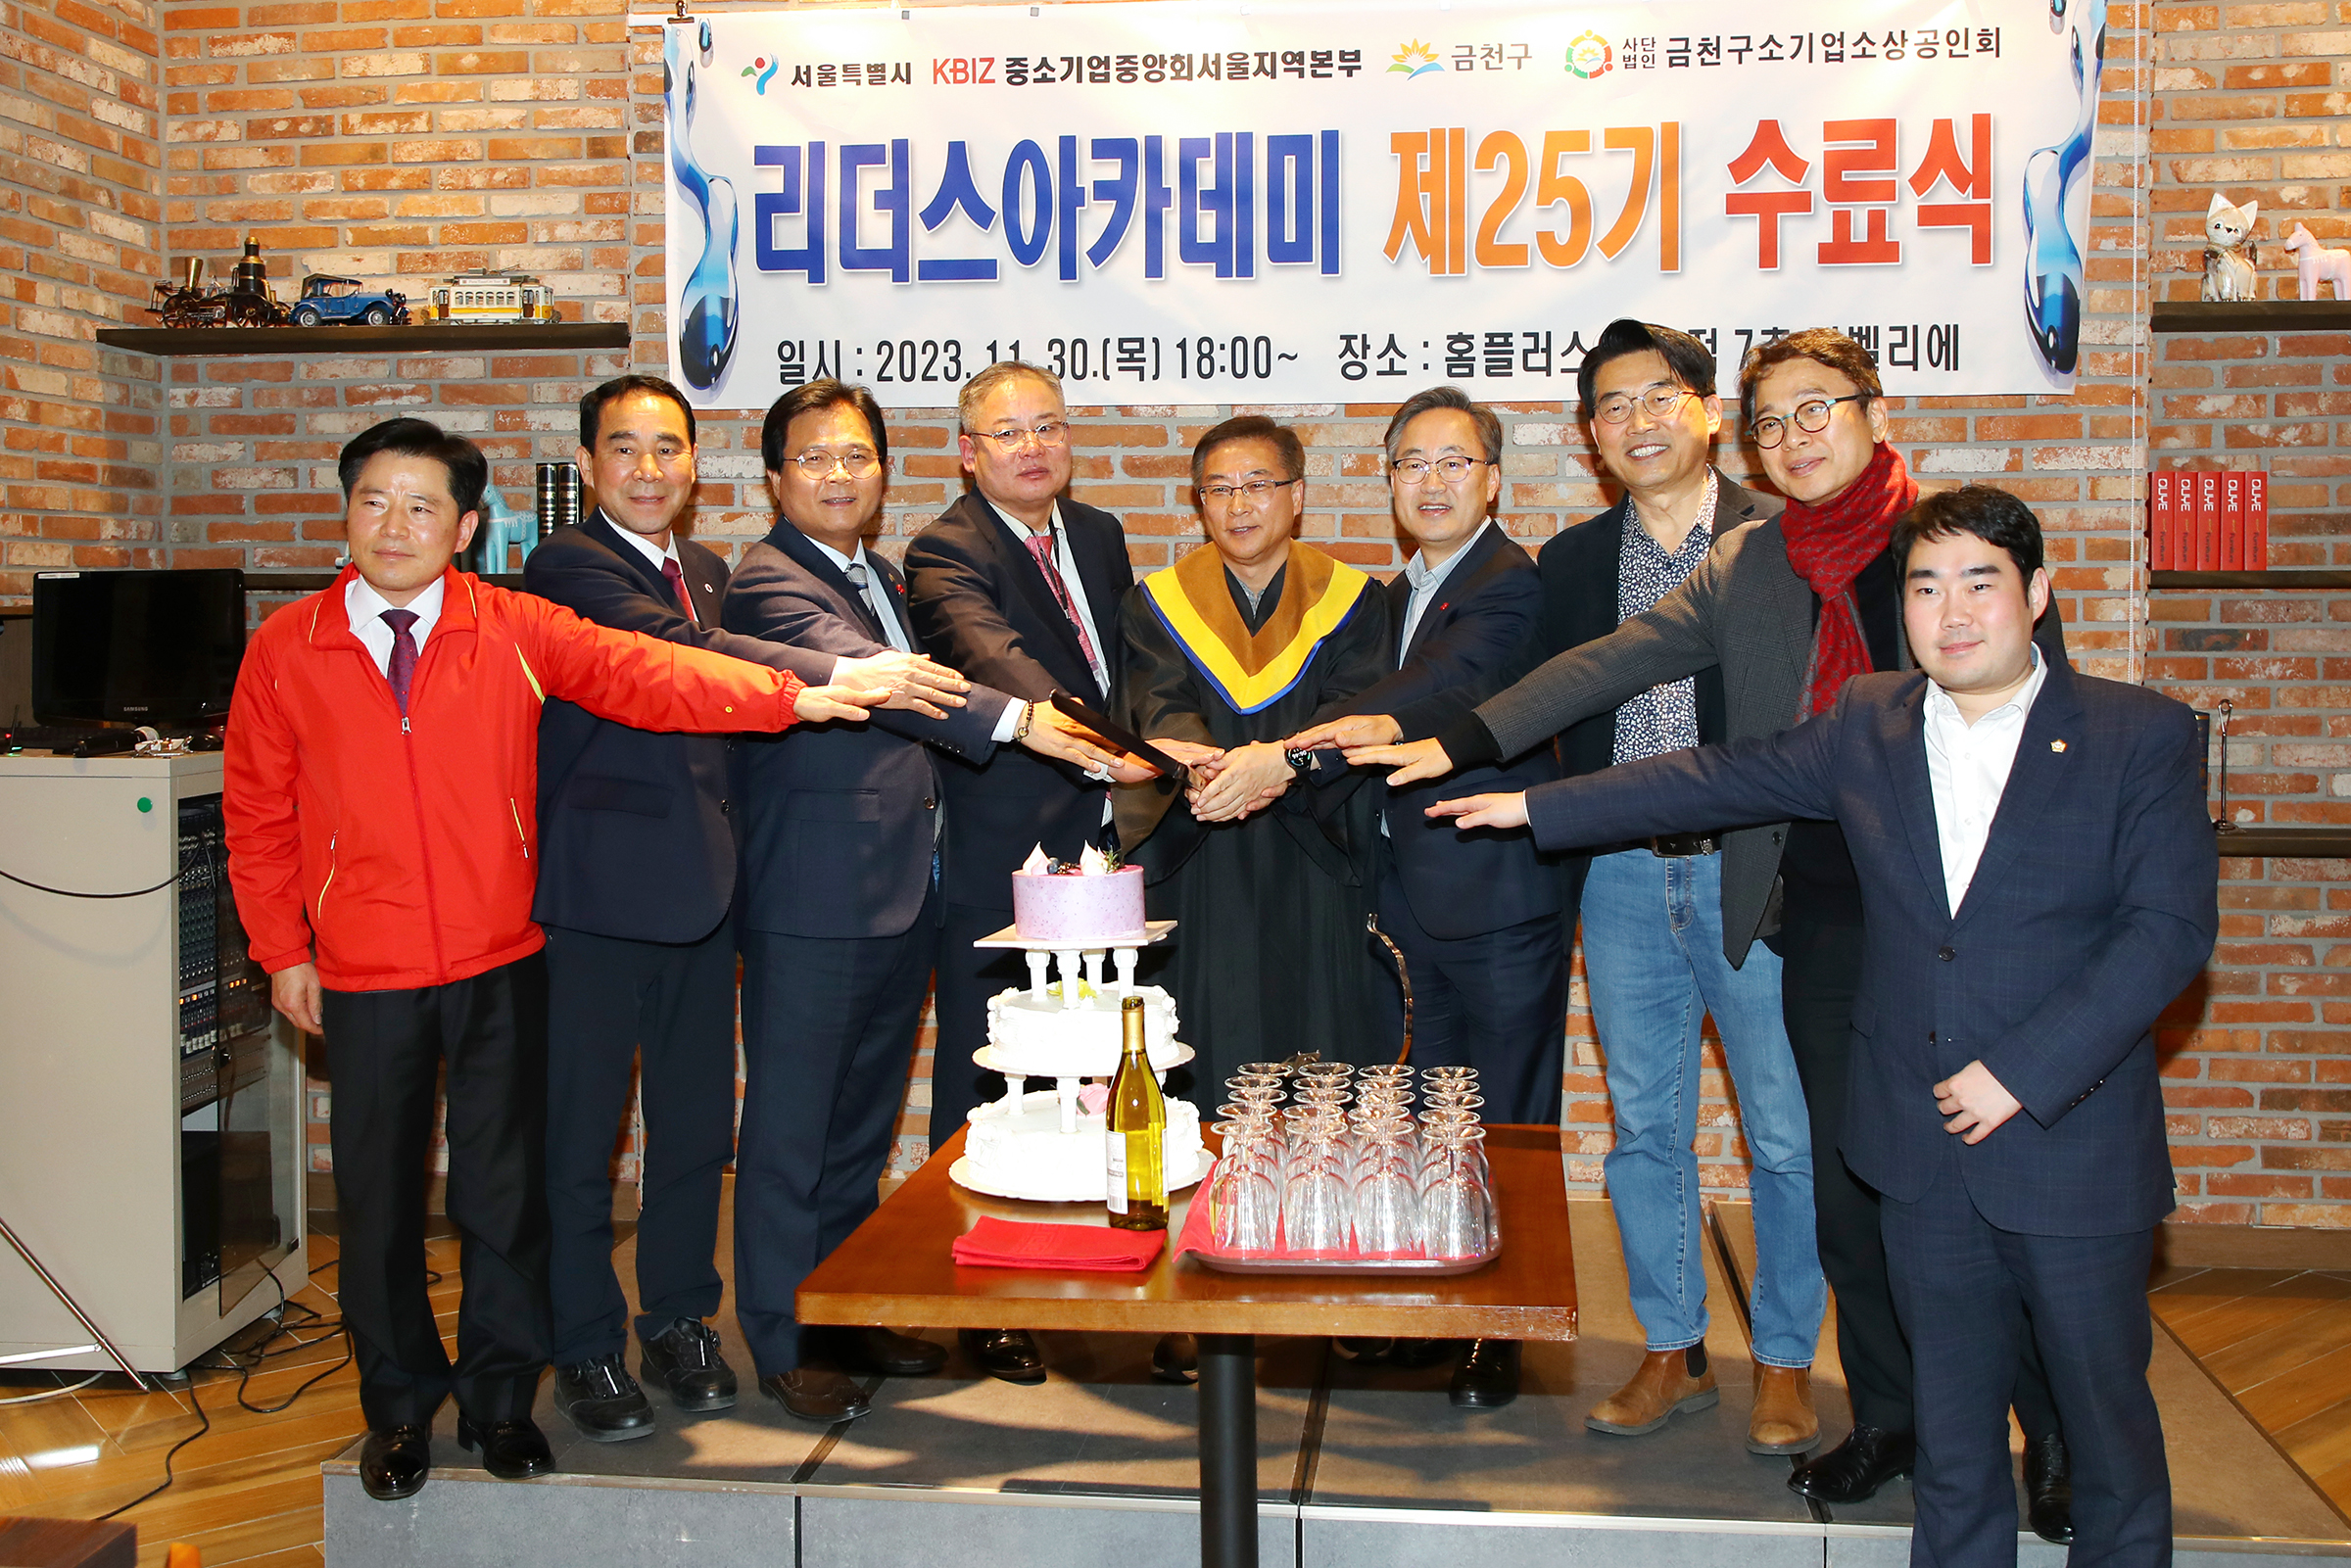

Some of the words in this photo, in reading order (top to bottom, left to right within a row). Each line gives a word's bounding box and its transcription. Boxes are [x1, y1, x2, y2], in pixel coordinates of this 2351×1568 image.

[1451, 41, 1534, 72] 금천구
[1622, 36, 1656, 52] 사단
[1665, 26, 2001, 69] 금천구소기업소상공인회
[791, 62, 912, 88] 서울특별시
[933, 57, 996, 85] KBIZ
[1005, 49, 1363, 86] 중소기업중앙회서울지역본부
[1622, 53, 1656, 70] 법인
[753, 129, 1340, 284] 리더스아카데미
[1383, 120, 1681, 275] 제25기
[1725, 113, 1992, 269] 수료식
[777, 339, 840, 385] 일시
[1176, 335, 1299, 380] 18:00~
[1337, 333, 1408, 381] 장소
[1444, 330, 1593, 378] 홈플러스
[1830, 323, 1959, 372] 벨리에
